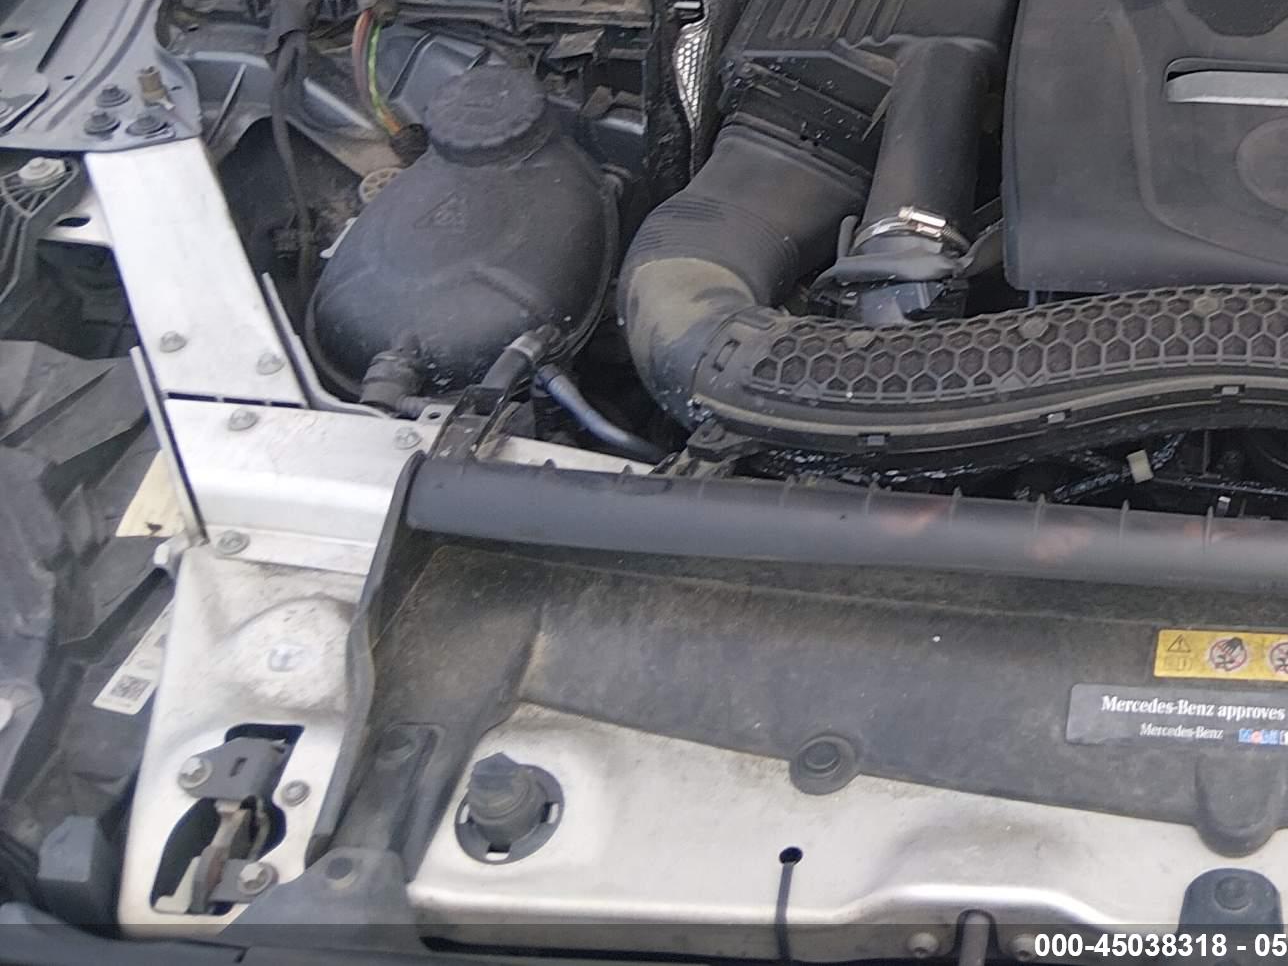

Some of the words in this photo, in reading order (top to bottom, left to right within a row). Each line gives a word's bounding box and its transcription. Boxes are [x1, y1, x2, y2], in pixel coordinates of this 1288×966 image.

[1101, 695, 1215, 716] Mercedes-Benz
[1217, 705, 1285, 722] approves
[1140, 722, 1224, 740] Mercedes-Benz
